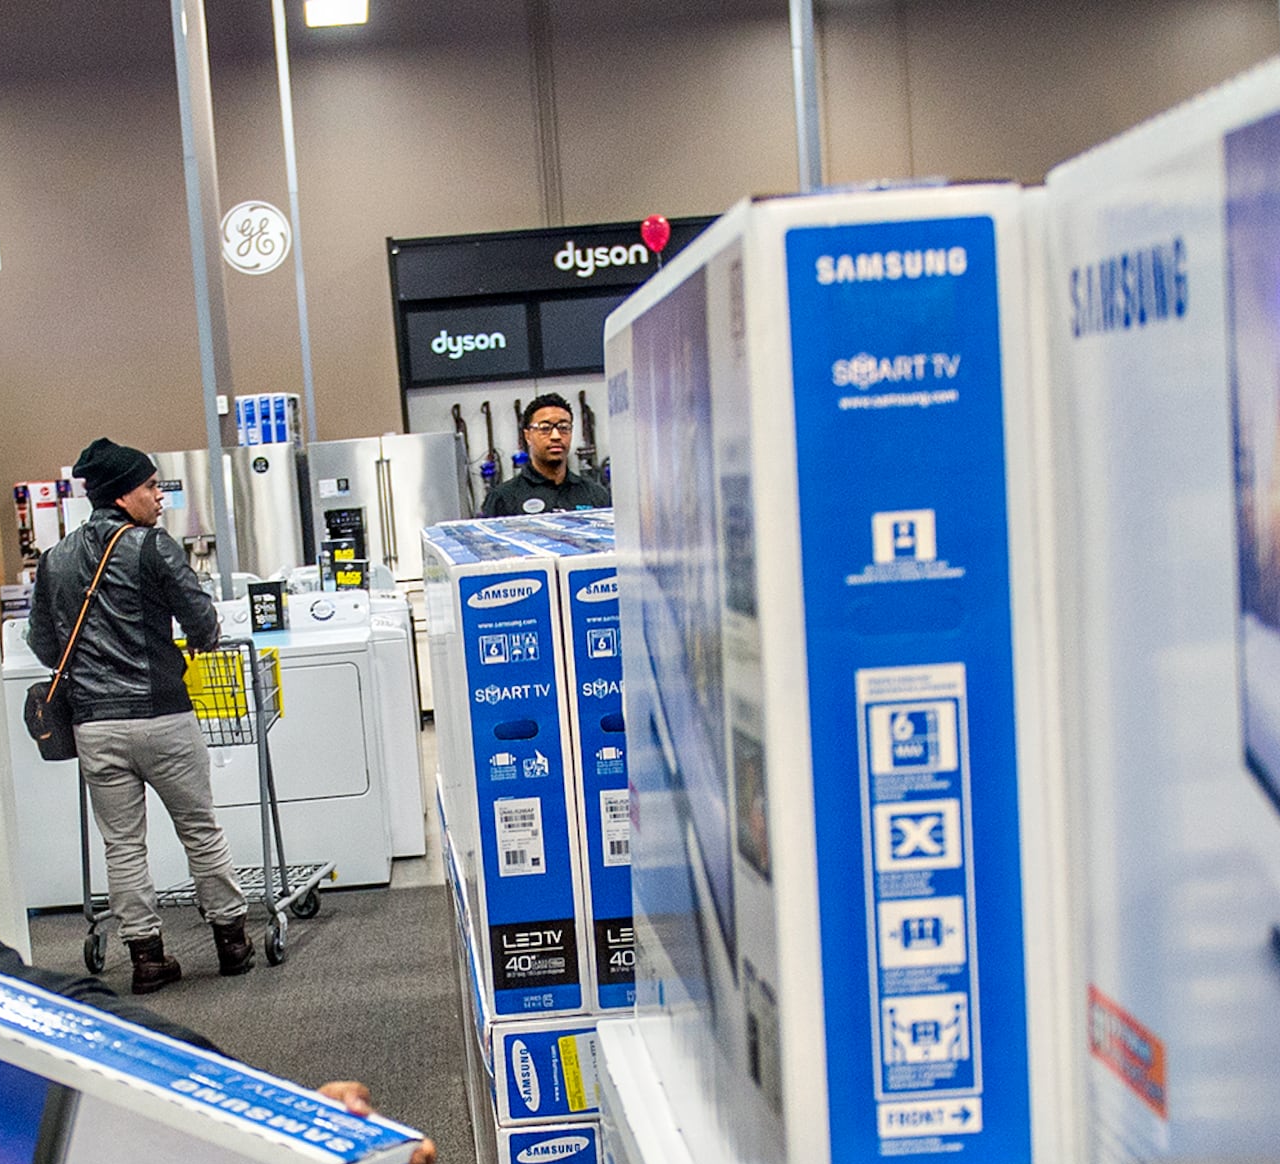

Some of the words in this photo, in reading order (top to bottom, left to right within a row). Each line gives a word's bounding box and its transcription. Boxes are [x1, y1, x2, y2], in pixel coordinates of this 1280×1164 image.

[554, 241, 649, 278] dyson
[816, 247, 968, 285] SAMSUNG
[1069, 236, 1189, 338] SAMSUNG
[431, 330, 507, 359] dyson
[932, 353, 961, 378] TV
[477, 586, 534, 601] SAMSUNG
[585, 583, 619, 595] SAMS
[475, 683, 531, 705] SMART
[533, 683, 551, 698] TV
[583, 678, 625, 699] SMA
[503, 932, 543, 949] LED
[543, 929, 563, 944] TV
[607, 928, 634, 942] LE
[609, 951, 635, 966] 40
[519, 1048, 533, 1103] SAMSUNG
[170, 1078, 356, 1154] SAMSUNG
[525, 1143, 582, 1157] SAMSUNG
